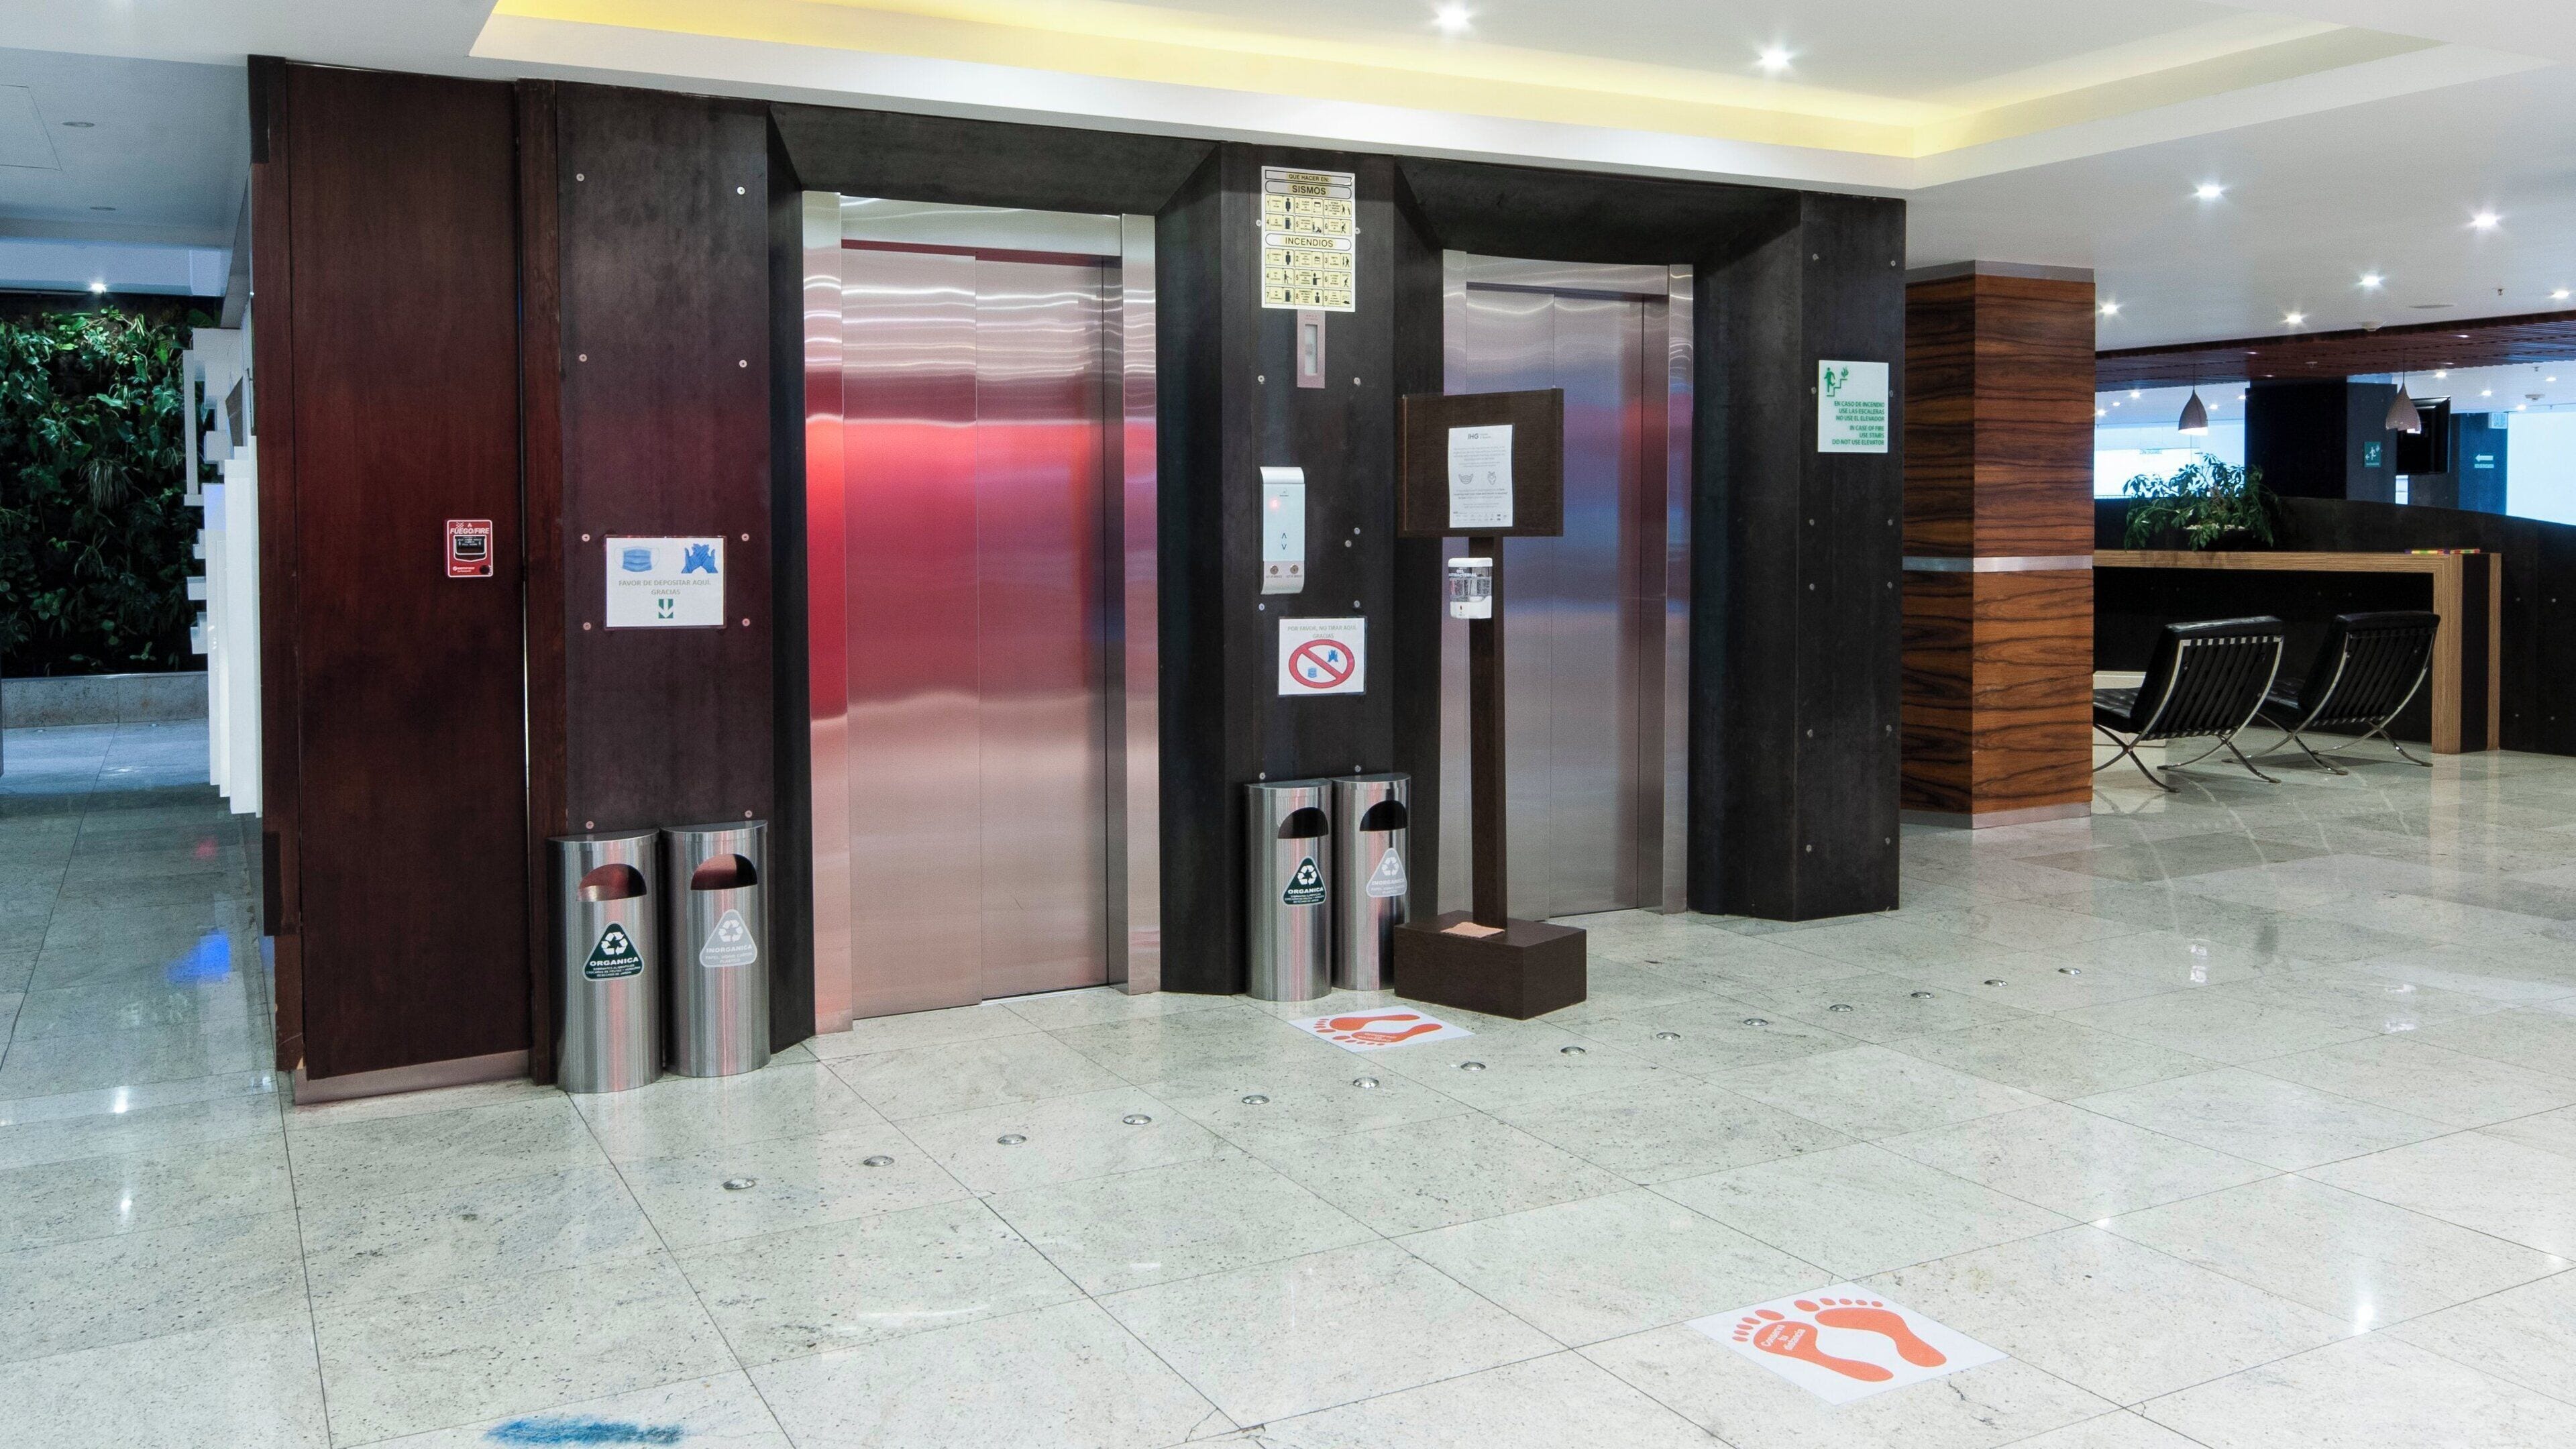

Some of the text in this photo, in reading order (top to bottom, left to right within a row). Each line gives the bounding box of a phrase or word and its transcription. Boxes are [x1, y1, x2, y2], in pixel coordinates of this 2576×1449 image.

[1292, 185, 1326, 195] SISMOS
[1285, 237, 1334, 247] INCENDIOS
[706, 945, 753, 953] INORGANICA
[590, 957, 639, 966] ORGANICA
